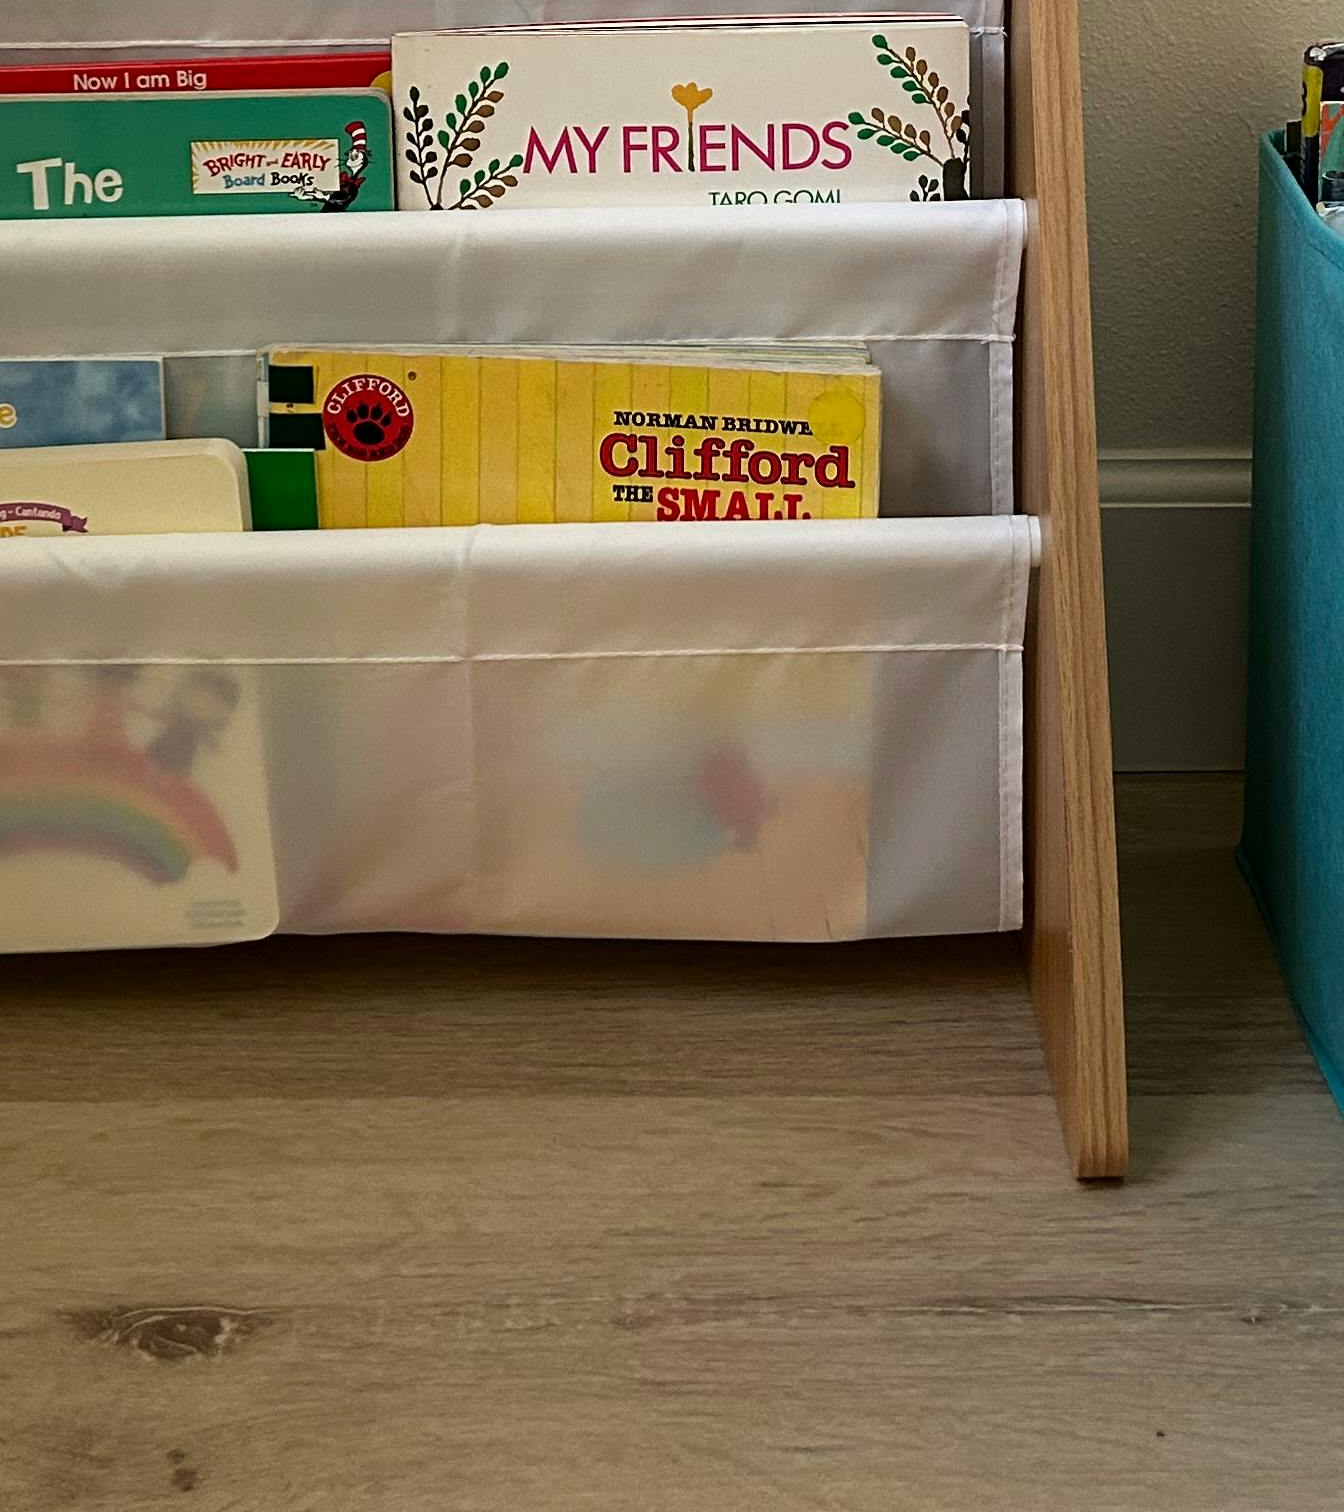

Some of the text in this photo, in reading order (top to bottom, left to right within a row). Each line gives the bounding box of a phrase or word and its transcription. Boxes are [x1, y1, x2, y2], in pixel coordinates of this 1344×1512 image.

[73, 69, 208, 91] Now I am Big
[522, 119, 853, 174] MY FRIENDS
[203, 151, 332, 177] BRIGHT EARLY
[16, 157, 124, 211] The
[222, 172, 314, 189] Board Books
[326, 377, 410, 418] CLIFFORD
[613, 410, 718, 431] NORMAN
[599, 432, 856, 488] Clifford
[612, 485, 653, 503] THE
[15, 506, 61, 520] Cantando
